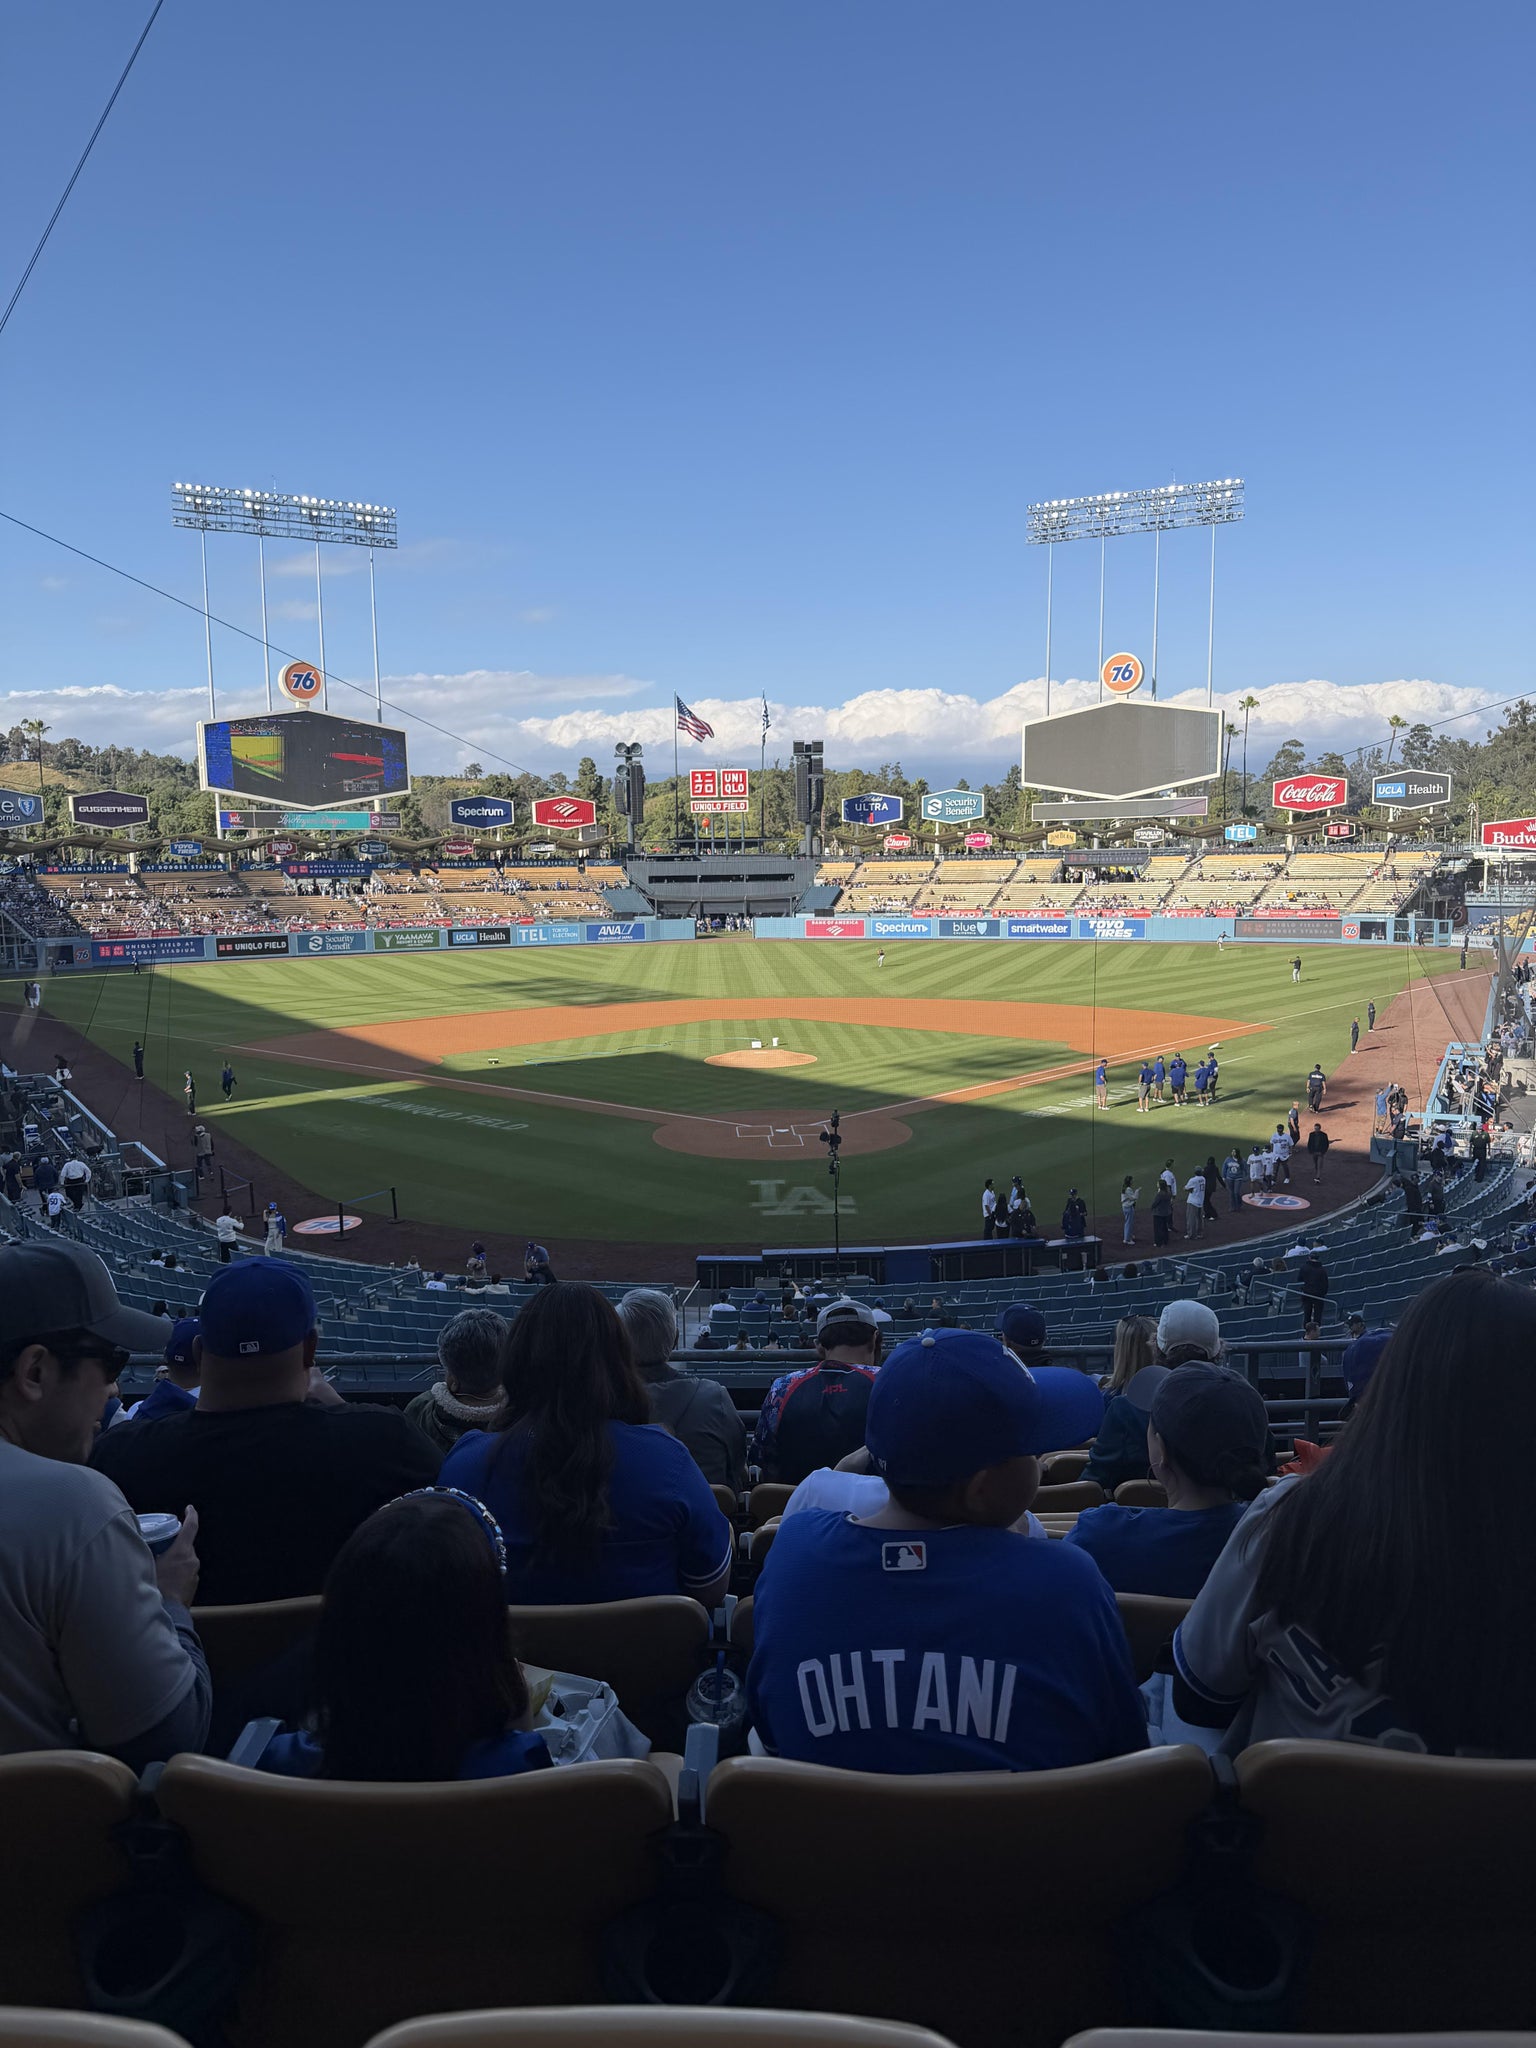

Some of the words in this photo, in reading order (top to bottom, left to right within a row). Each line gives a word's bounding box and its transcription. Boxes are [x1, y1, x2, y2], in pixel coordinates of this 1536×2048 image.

[1110, 662, 1134, 683] 76
[290, 671, 316, 691] 76
[694, 773, 713, 783] ユニ
[724, 773, 743, 783] UNI
[725, 783, 744, 794] QLO
[1279, 782, 1339, 803] Coca-Cola
[1378, 786, 1403, 794] UCLA
[1408, 784, 1444, 795] Health
[694, 803, 722, 811] UNIQLO
[723, 802, 745, 810] FIELD
[855, 802, 889, 811] ULTRA
[945, 797, 978, 808] Security
[457, 806, 504, 818] Spectrum
[945, 807, 974, 816] Benefit
[1229, 827, 1253, 838] TEL
[271, 842, 293, 852] JINRO
[885, 838, 910, 847] Churu
[875, 922, 924, 935] Spectrum
[953, 922, 977, 932] blue
[1011, 923, 1069, 934] smartwater
[1088, 920, 1125, 929] TOYO
[519, 928, 548, 942] TEL
[598, 925, 621, 935] ANA
[1094, 928, 1133, 938] TIRES
[1344, 926, 1358, 935] 76
[325, 934, 355, 944] Security
[479, 932, 506, 941] Health
[234, 942, 263, 951] UNIQLO
[264, 941, 287, 949] FIELD
[326, 942, 351, 951] Benefit
[75, 949, 89, 960] 76
[456, 1113, 530, 1130] FIELD
[748, 1179, 858, 1215] LA
[1251, 1195, 1302, 1208] 76
[300, 1217, 354, 1232] 76
[797, 1649, 1017, 1744] OHTANI
